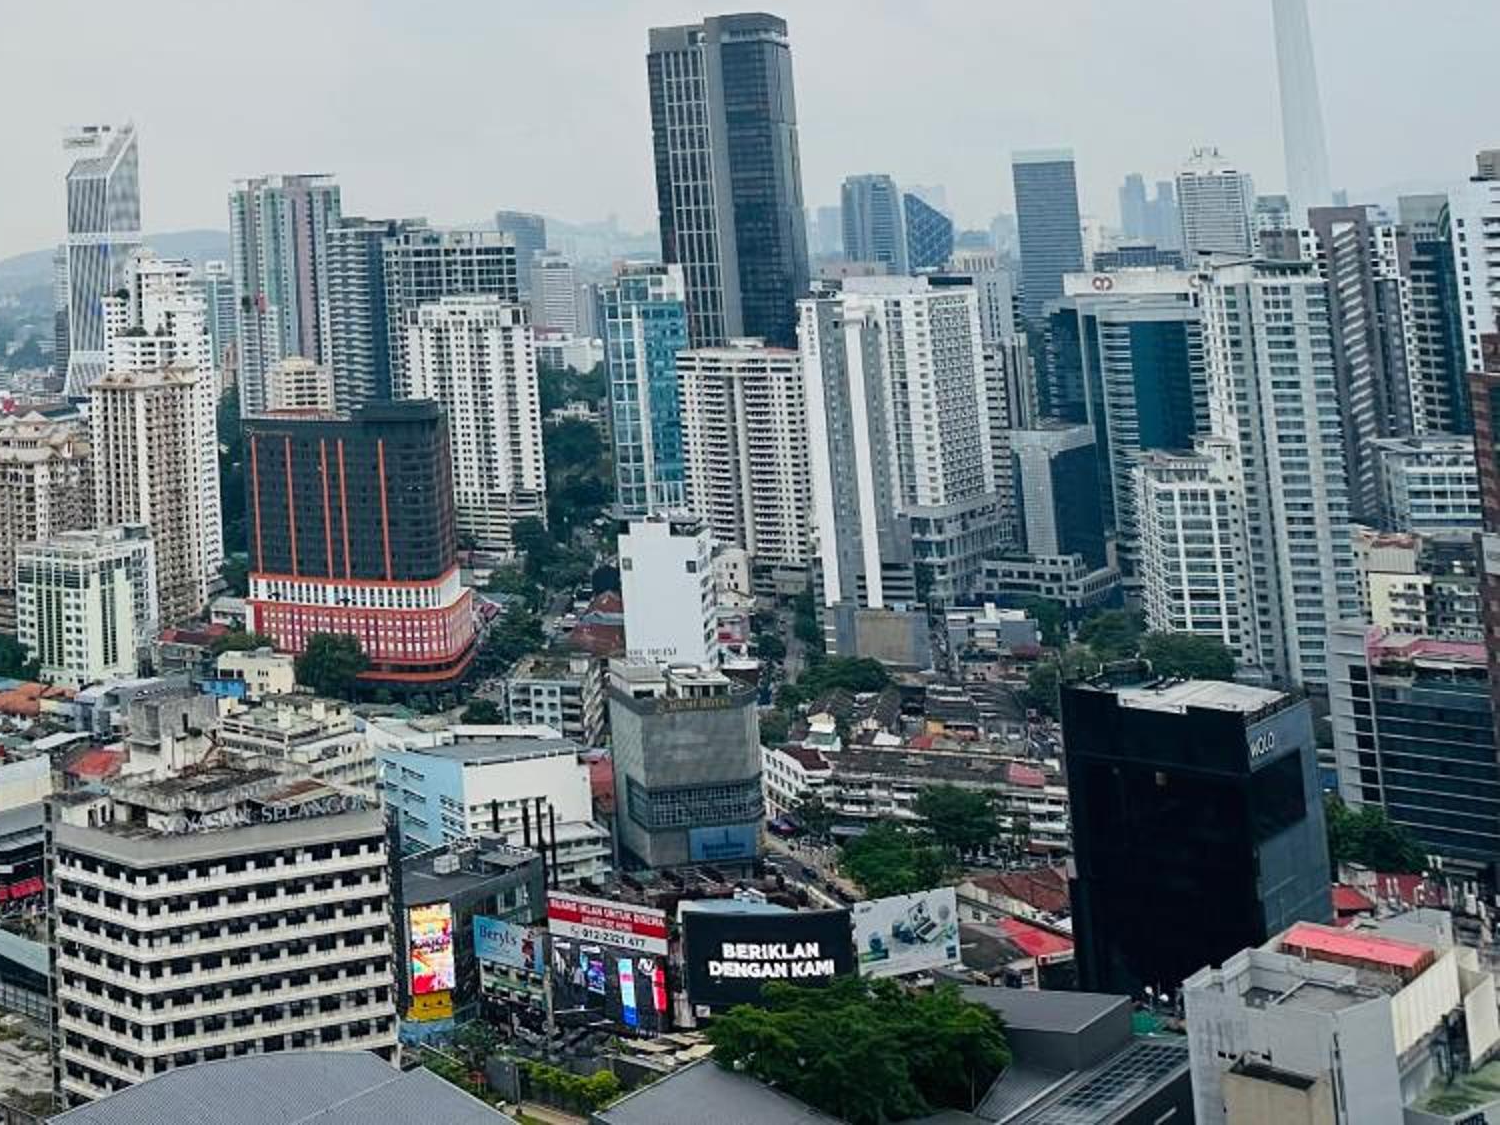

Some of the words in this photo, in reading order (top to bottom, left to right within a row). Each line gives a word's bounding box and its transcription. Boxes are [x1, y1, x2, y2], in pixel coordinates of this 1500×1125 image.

[721, 942, 820, 960] BERIKLAN
[708, 960, 789, 978] DENGAN
[791, 959, 835, 978] KAMI
